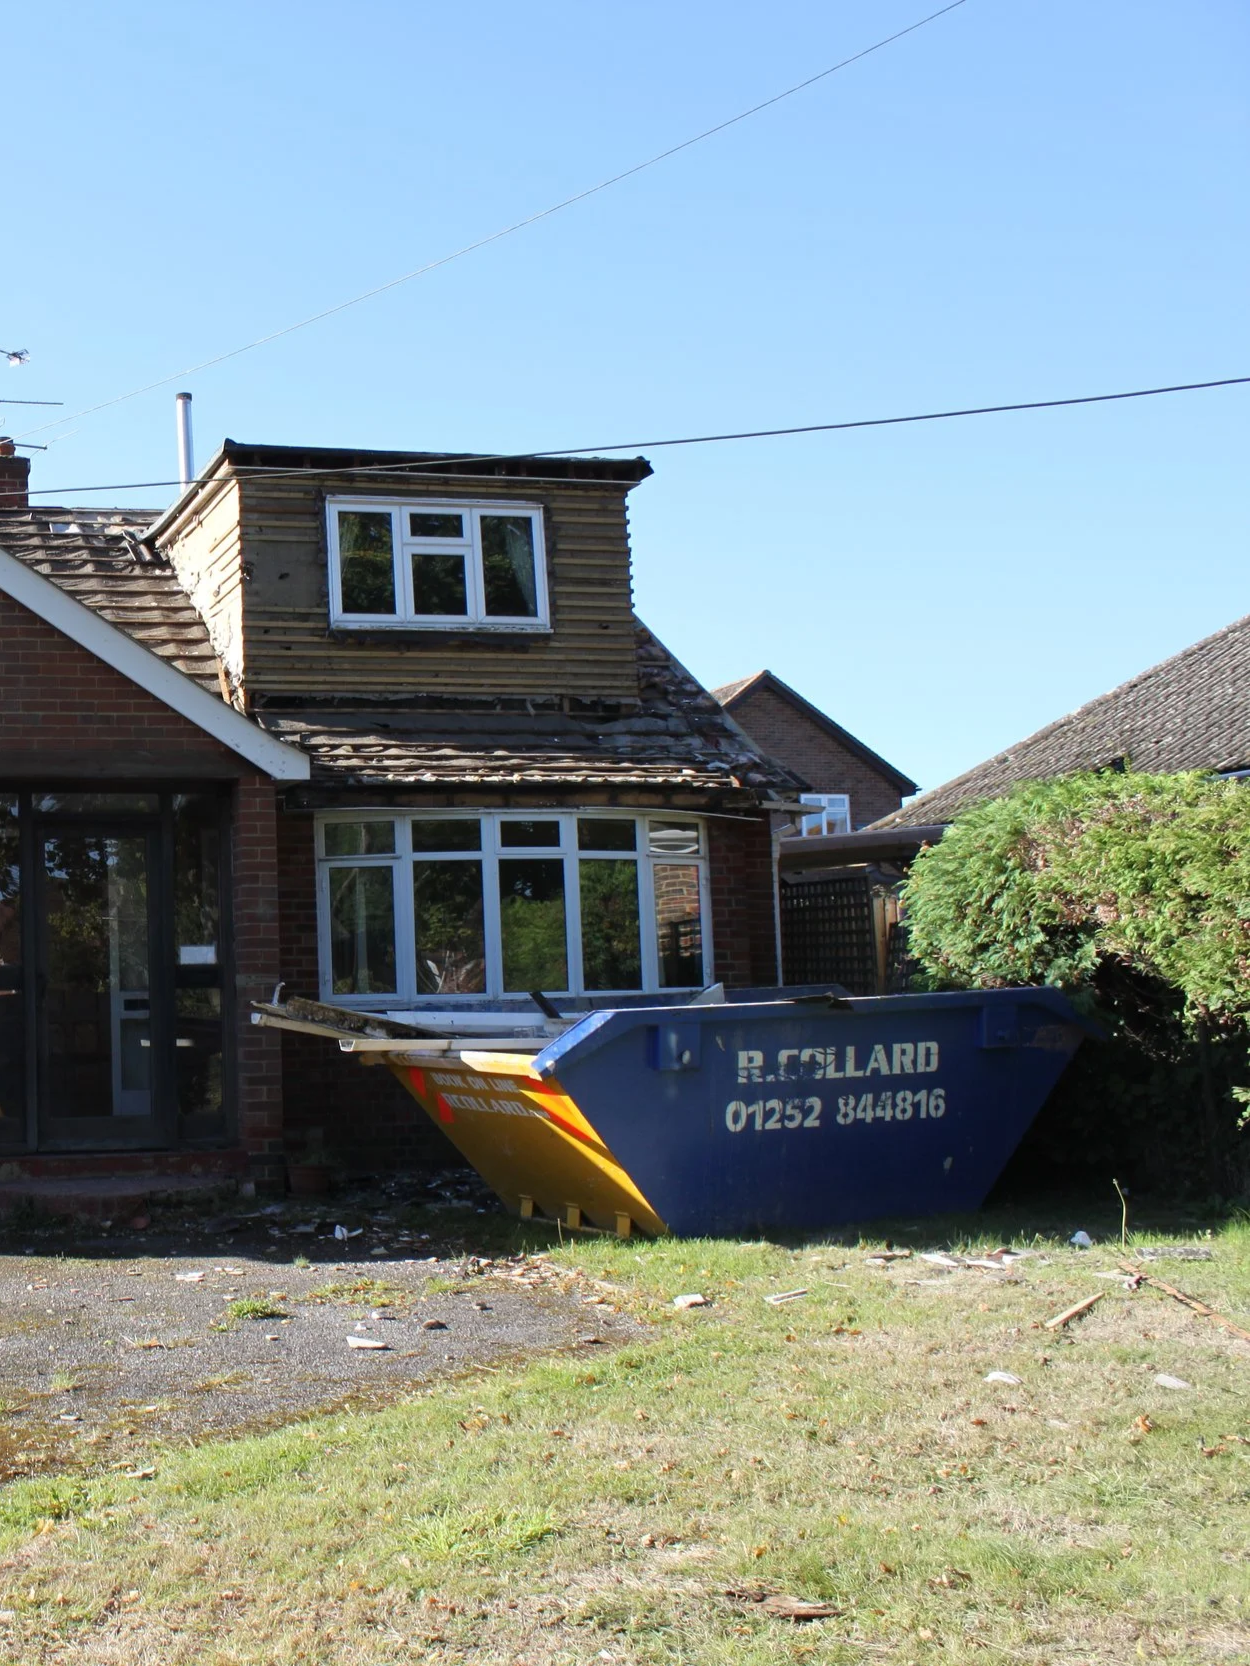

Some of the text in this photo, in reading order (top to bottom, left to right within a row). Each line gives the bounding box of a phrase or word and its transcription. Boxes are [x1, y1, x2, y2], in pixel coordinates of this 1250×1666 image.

[431, 1072, 519, 1093] BOOK ON LINE
[737, 1041, 939, 1083] R.COLLARD
[726, 1088, 946, 1132] 01252 844816
